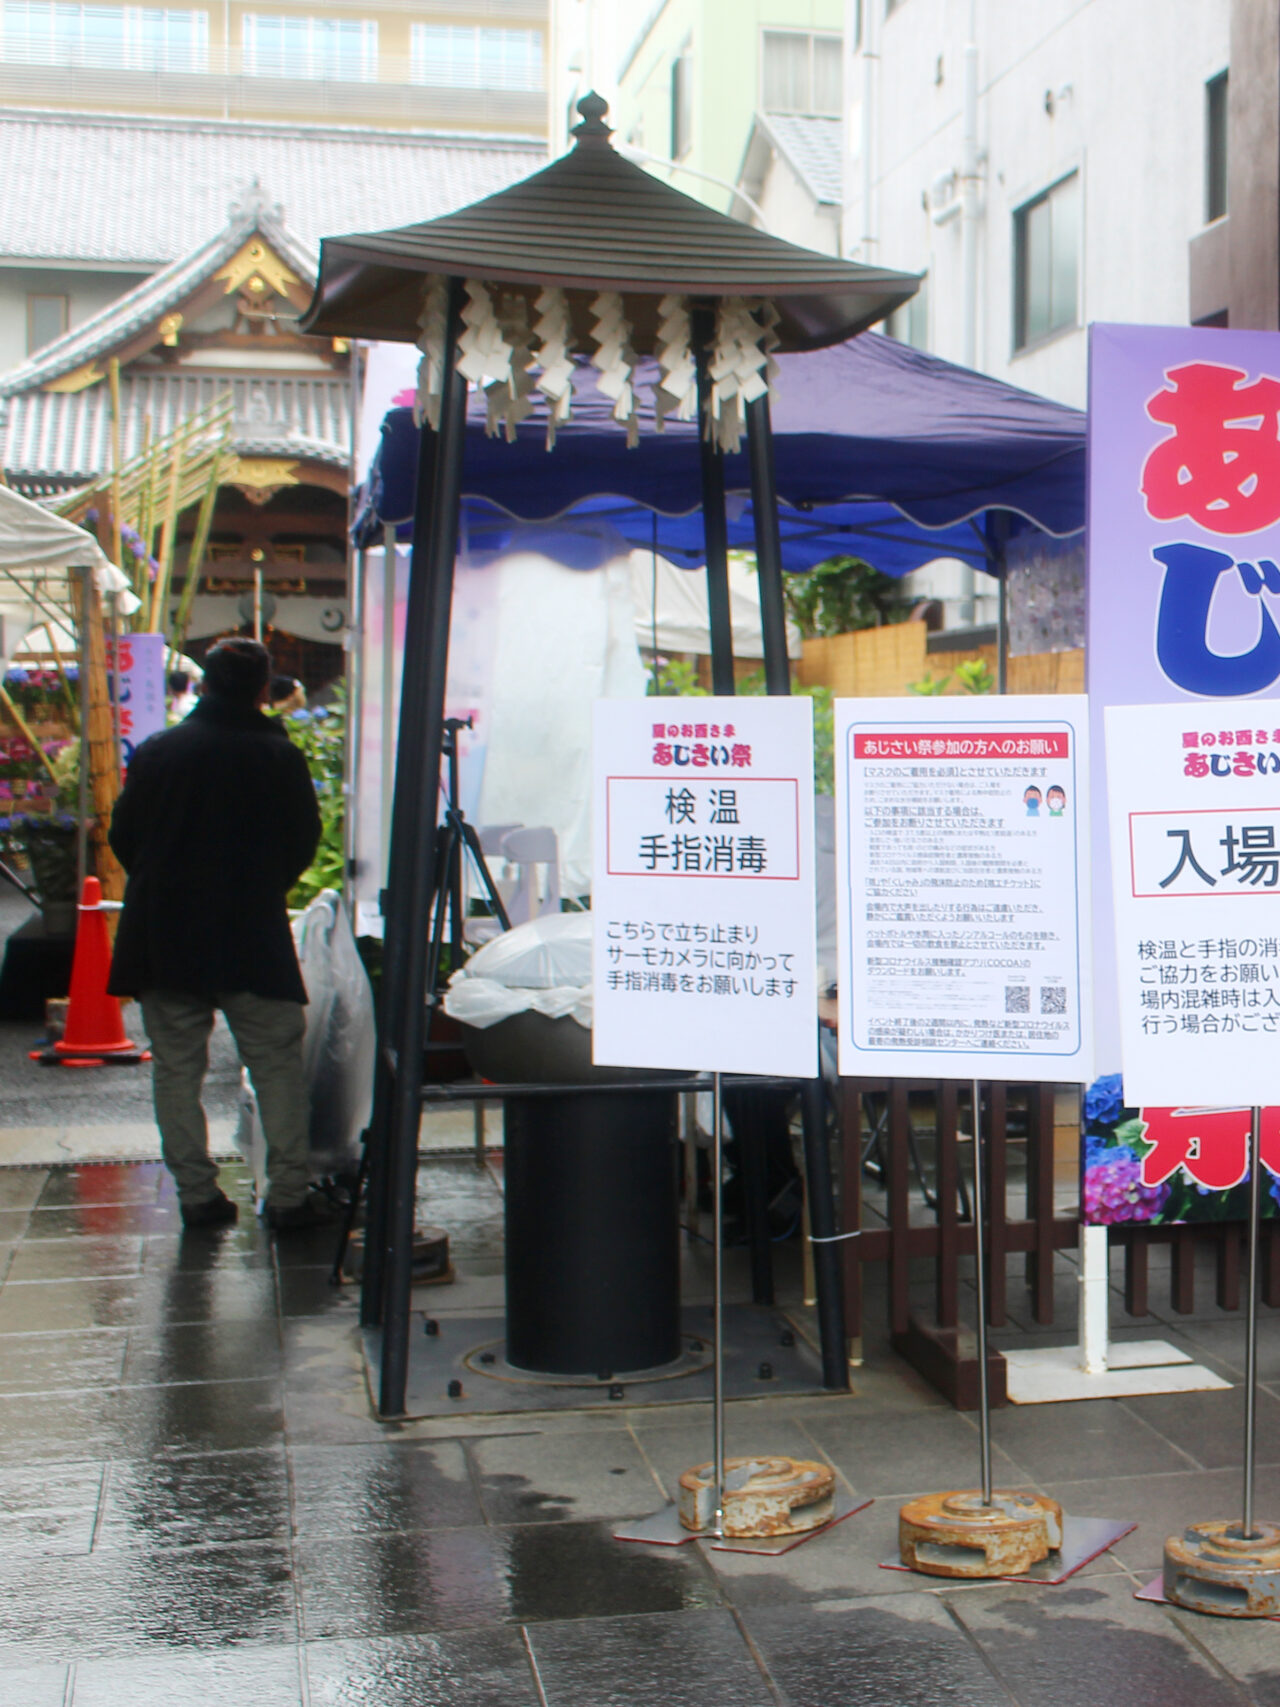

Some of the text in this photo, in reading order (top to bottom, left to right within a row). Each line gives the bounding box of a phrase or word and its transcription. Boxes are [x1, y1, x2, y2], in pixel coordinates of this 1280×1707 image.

[653, 743, 751, 767] あじさい祭
[864, 740, 1058, 756] あじさい祭参加の方へのお願い
[665, 787, 740, 824] 検温
[639, 834, 767, 873] 手指消毒
[607, 921, 758, 944] こちらで立ち止まり
[607, 946, 794, 973] サーモカメラに向かって
[607, 970, 798, 998] 手指消毒をお願いします
